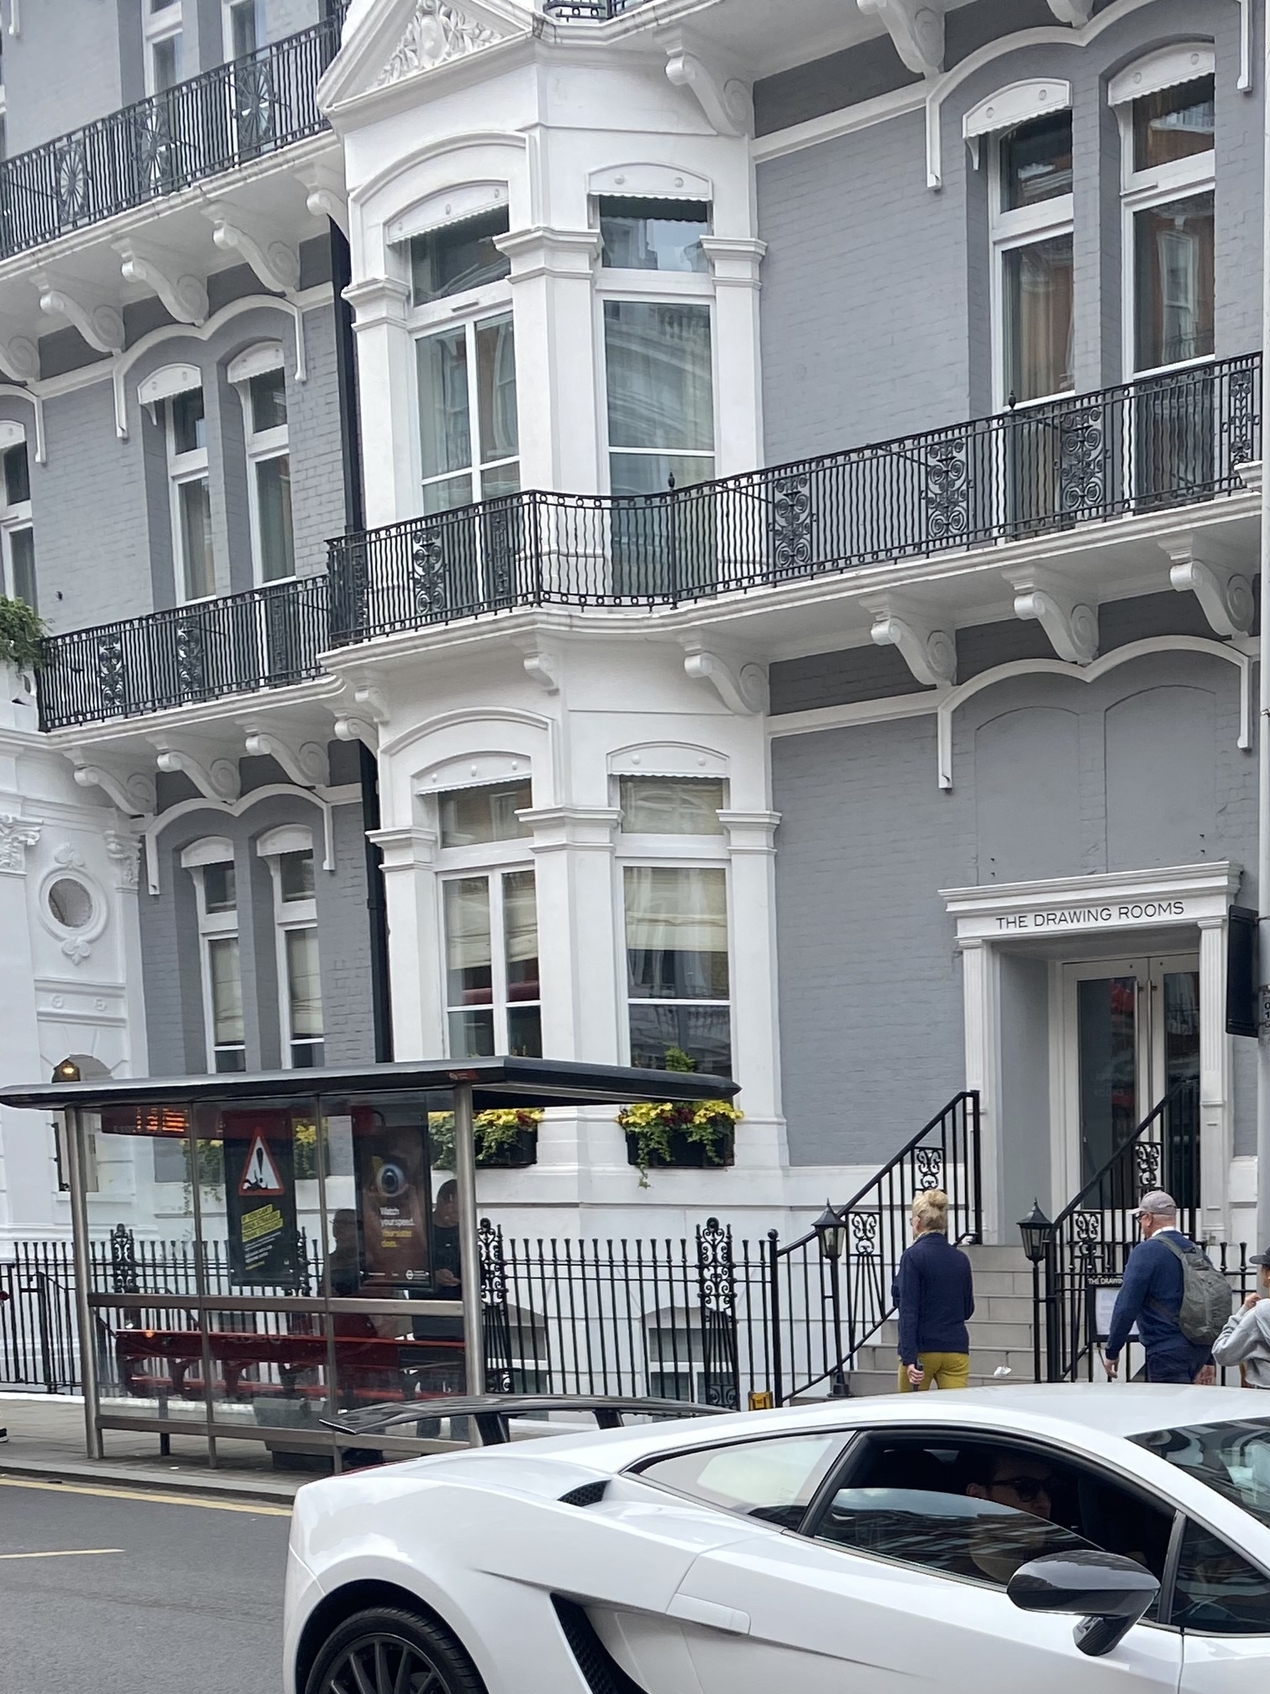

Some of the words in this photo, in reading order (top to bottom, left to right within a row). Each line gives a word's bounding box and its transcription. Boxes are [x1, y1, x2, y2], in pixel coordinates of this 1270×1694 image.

[996, 915, 1028, 930] THE
[1034, 908, 1112, 927] DRAWING
[1119, 902, 1185, 920] ROOMS
[1087, 1277, 1100, 1285] THE
[1100, 1277, 1124, 1285] DRAWIN
